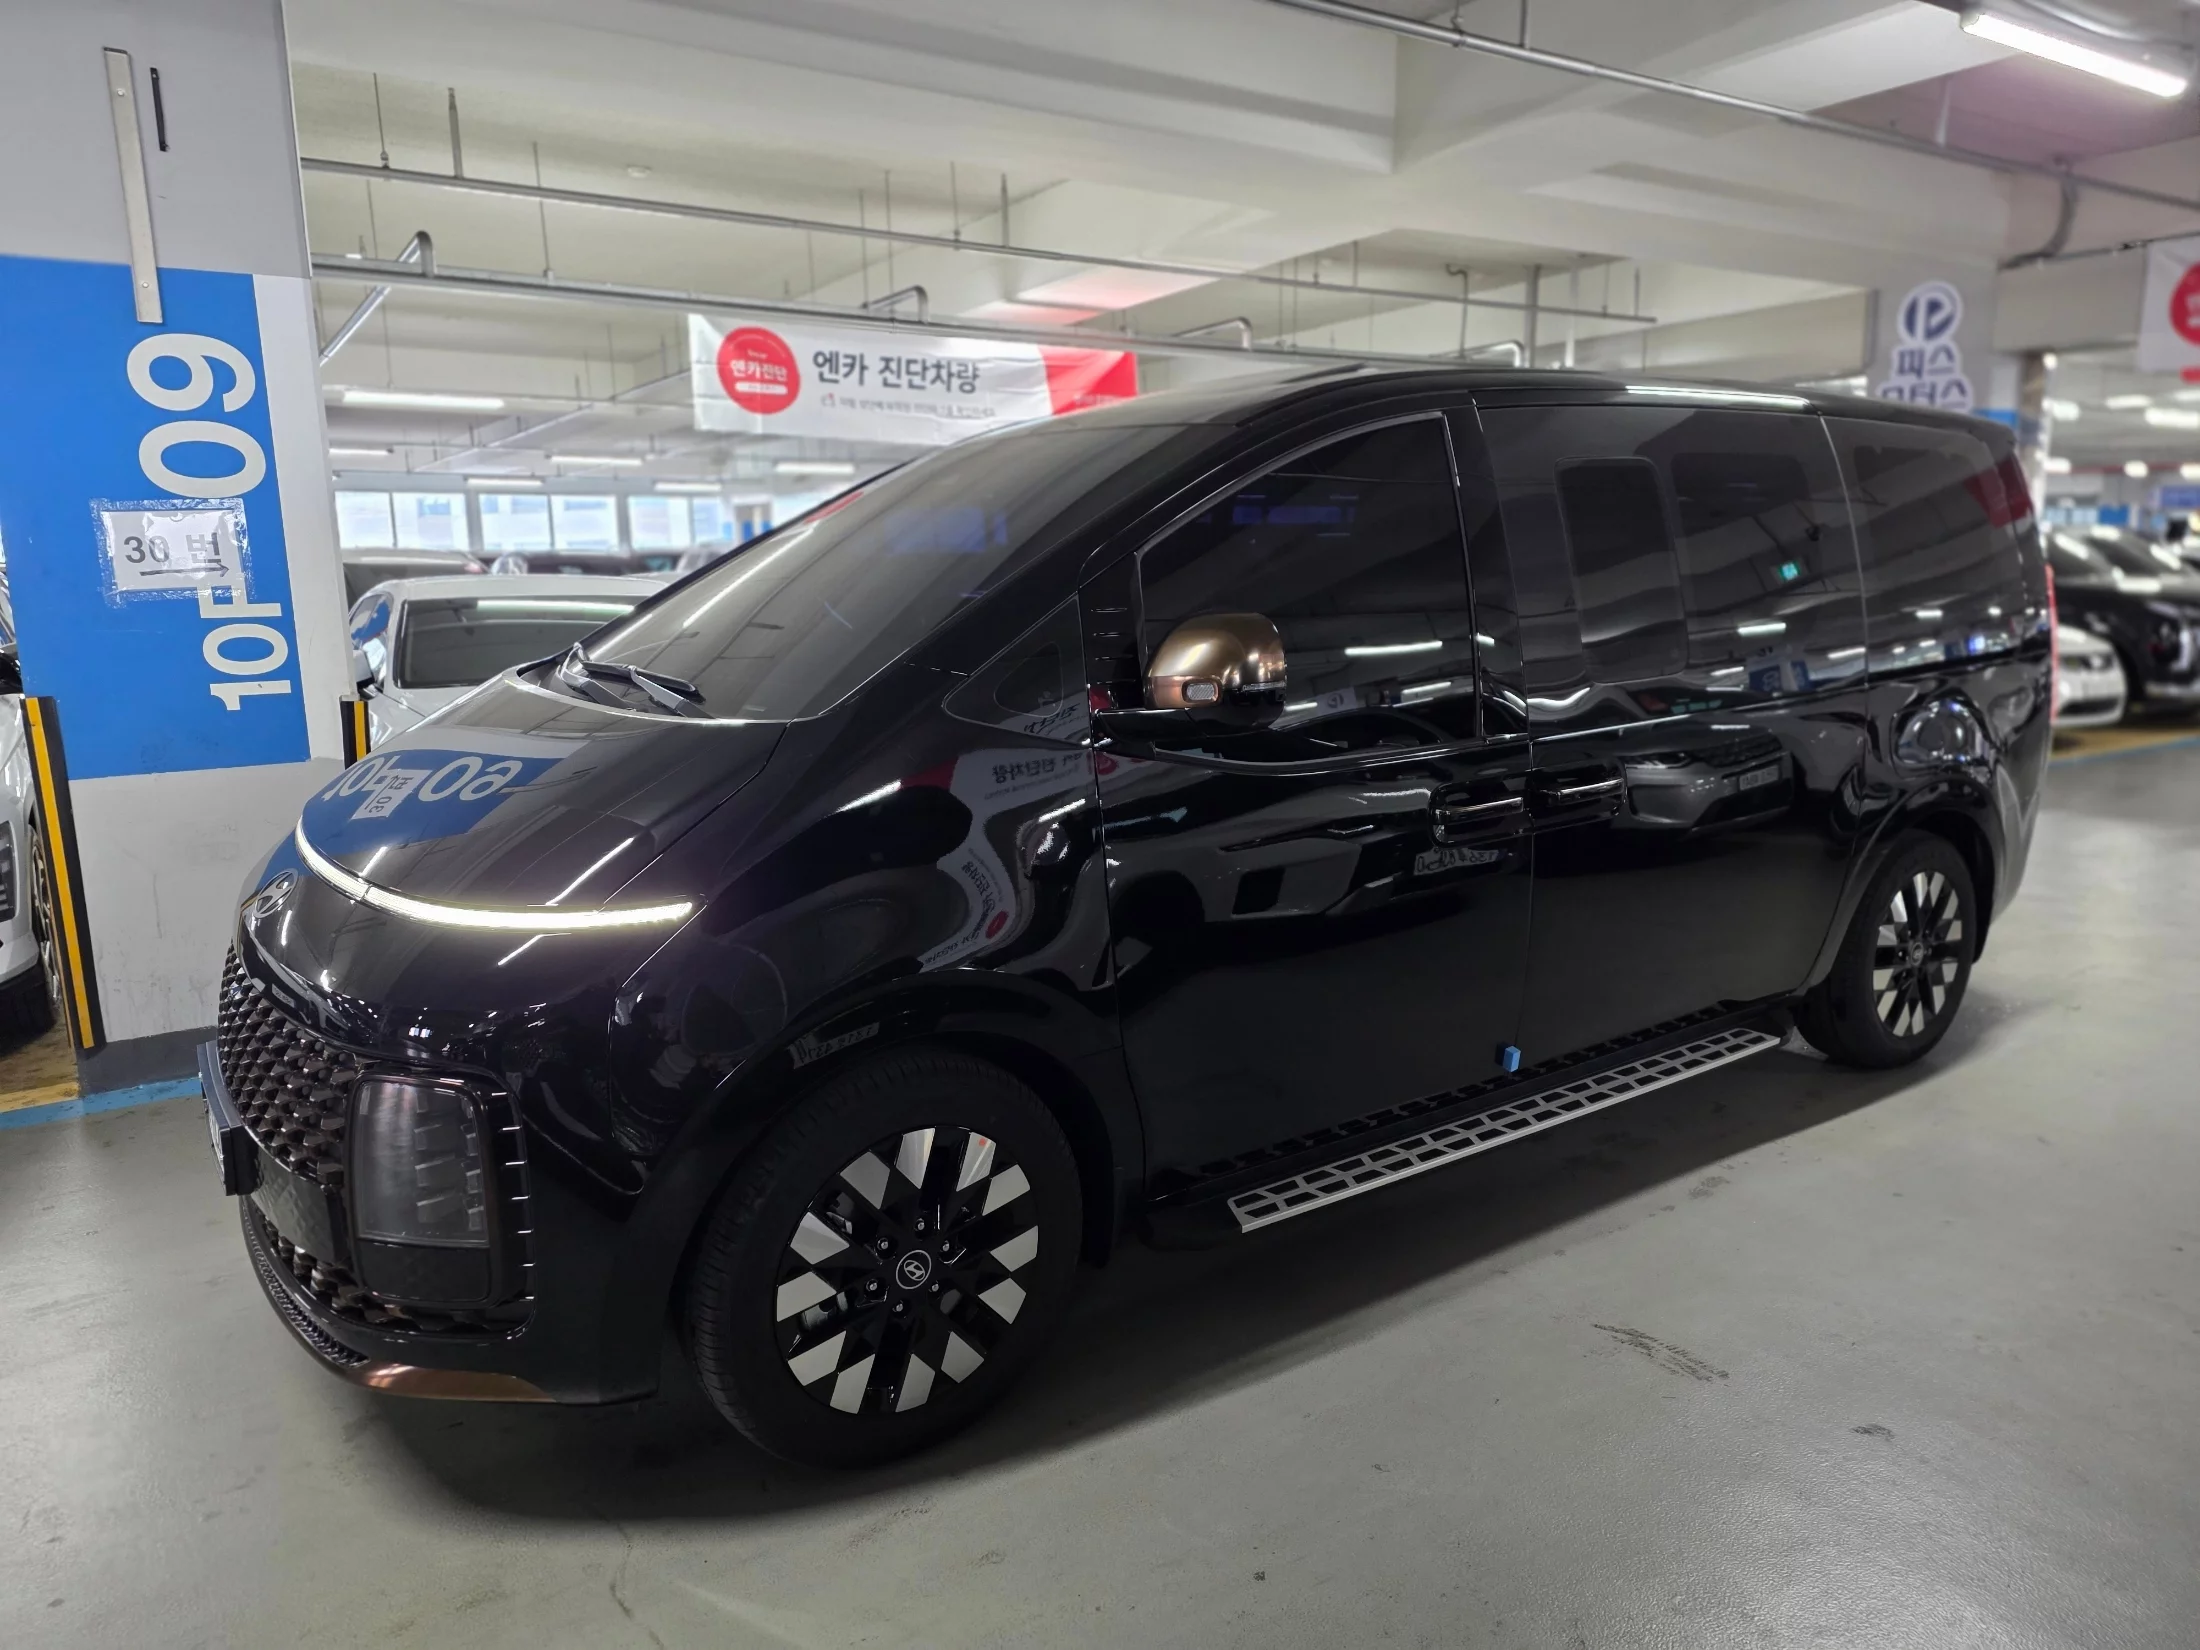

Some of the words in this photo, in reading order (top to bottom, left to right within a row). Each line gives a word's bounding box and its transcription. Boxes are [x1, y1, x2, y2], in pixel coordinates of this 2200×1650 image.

[813, 350, 869, 386] 엔카
[878, 356, 980, 394] 진단차량
[1897, 344, 1955, 379] 피스
[127, 333, 267, 499] 09
[123, 535, 170, 564] 30
[185, 532, 222, 564] 번
